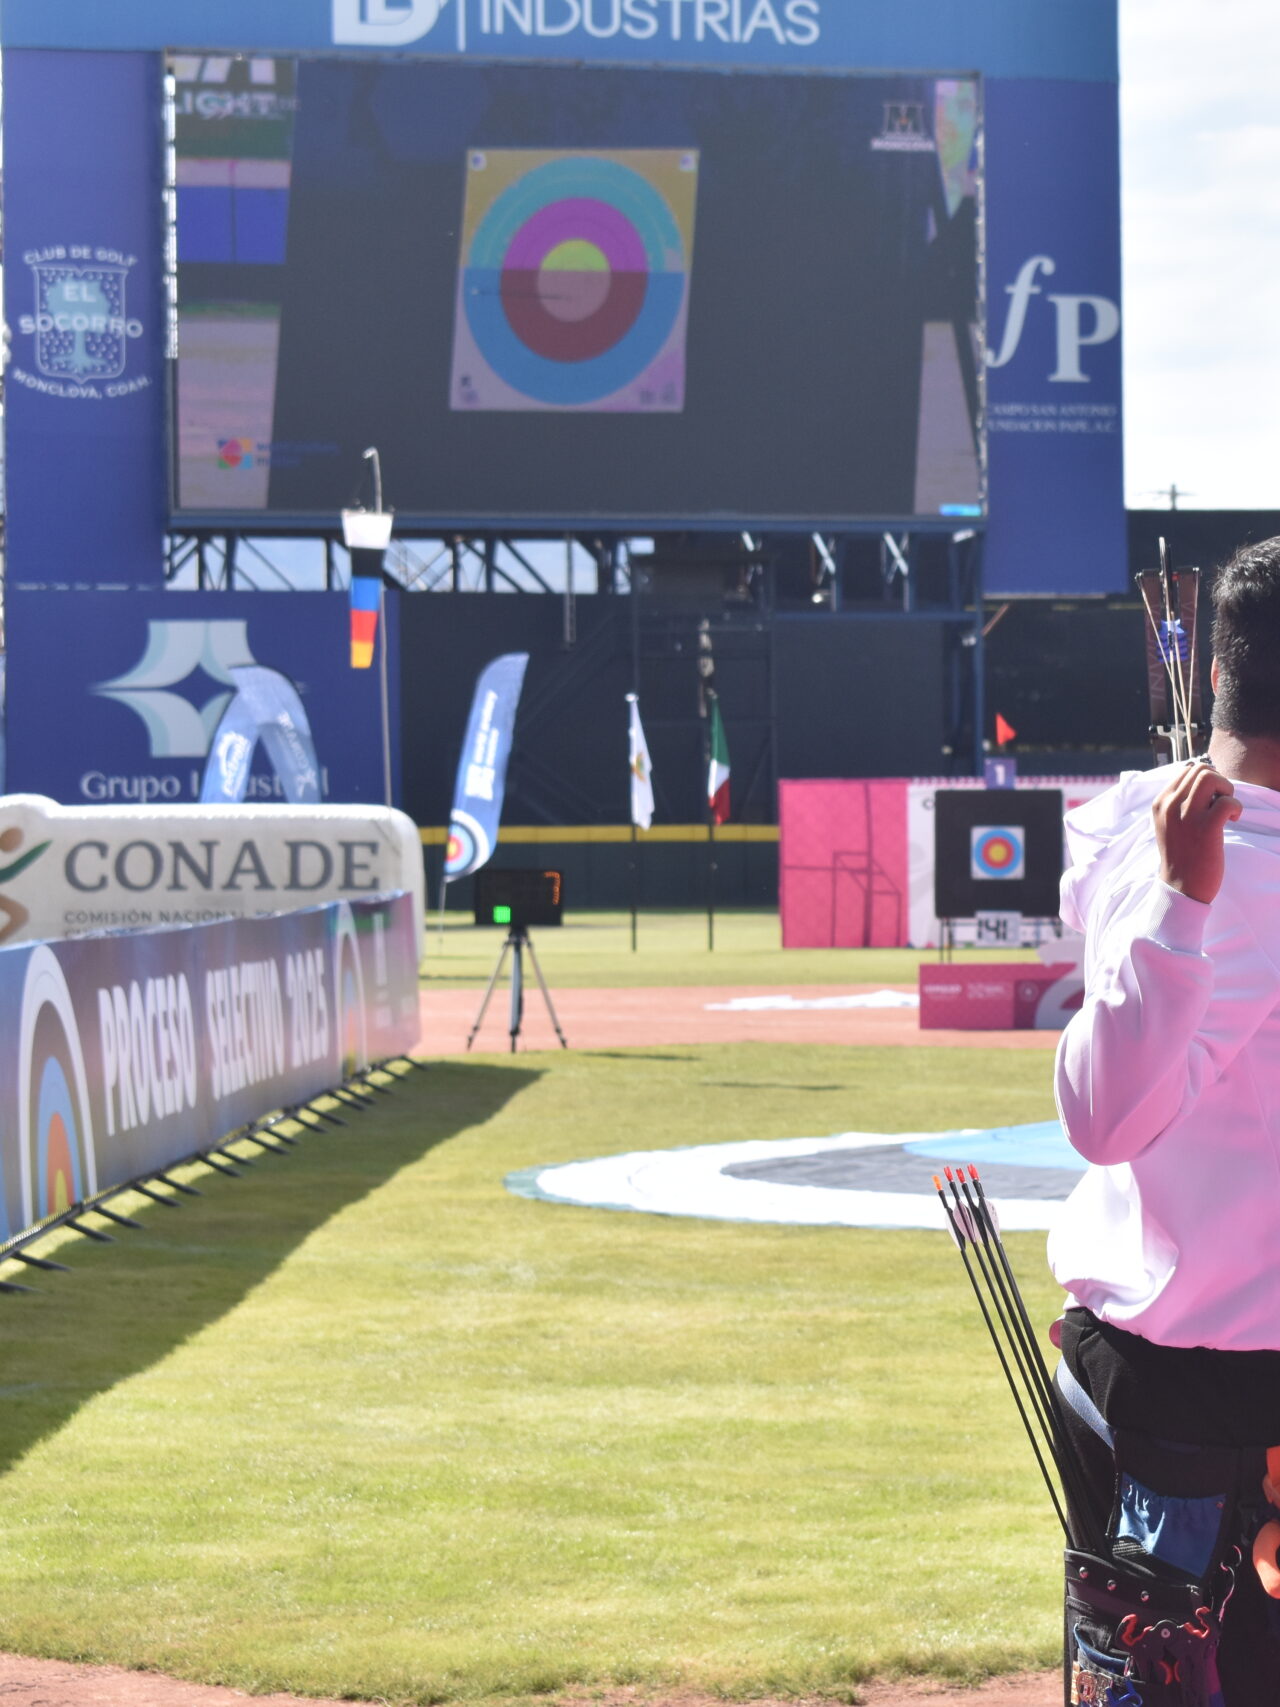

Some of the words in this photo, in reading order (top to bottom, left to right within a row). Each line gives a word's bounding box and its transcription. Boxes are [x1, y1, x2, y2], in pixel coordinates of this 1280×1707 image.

[480, 0, 820, 45] INDUSTRIAS
[23, 246, 66, 265] CLUB
[71, 245, 91, 259] DE
[96, 249, 138, 267] GOLF
[64, 284, 96, 302] EL
[19, 313, 144, 338] SOCORRO
[80, 770, 182, 803] Grupo
[994, 764, 1006, 786] 1
[64, 839, 380, 892] CONADE
[64, 910, 152, 924] COMISIÓN
[99, 972, 197, 1137] PROCESO
[206, 958, 285, 1101] SELECTIVO
[286, 948, 330, 1068] 2025
